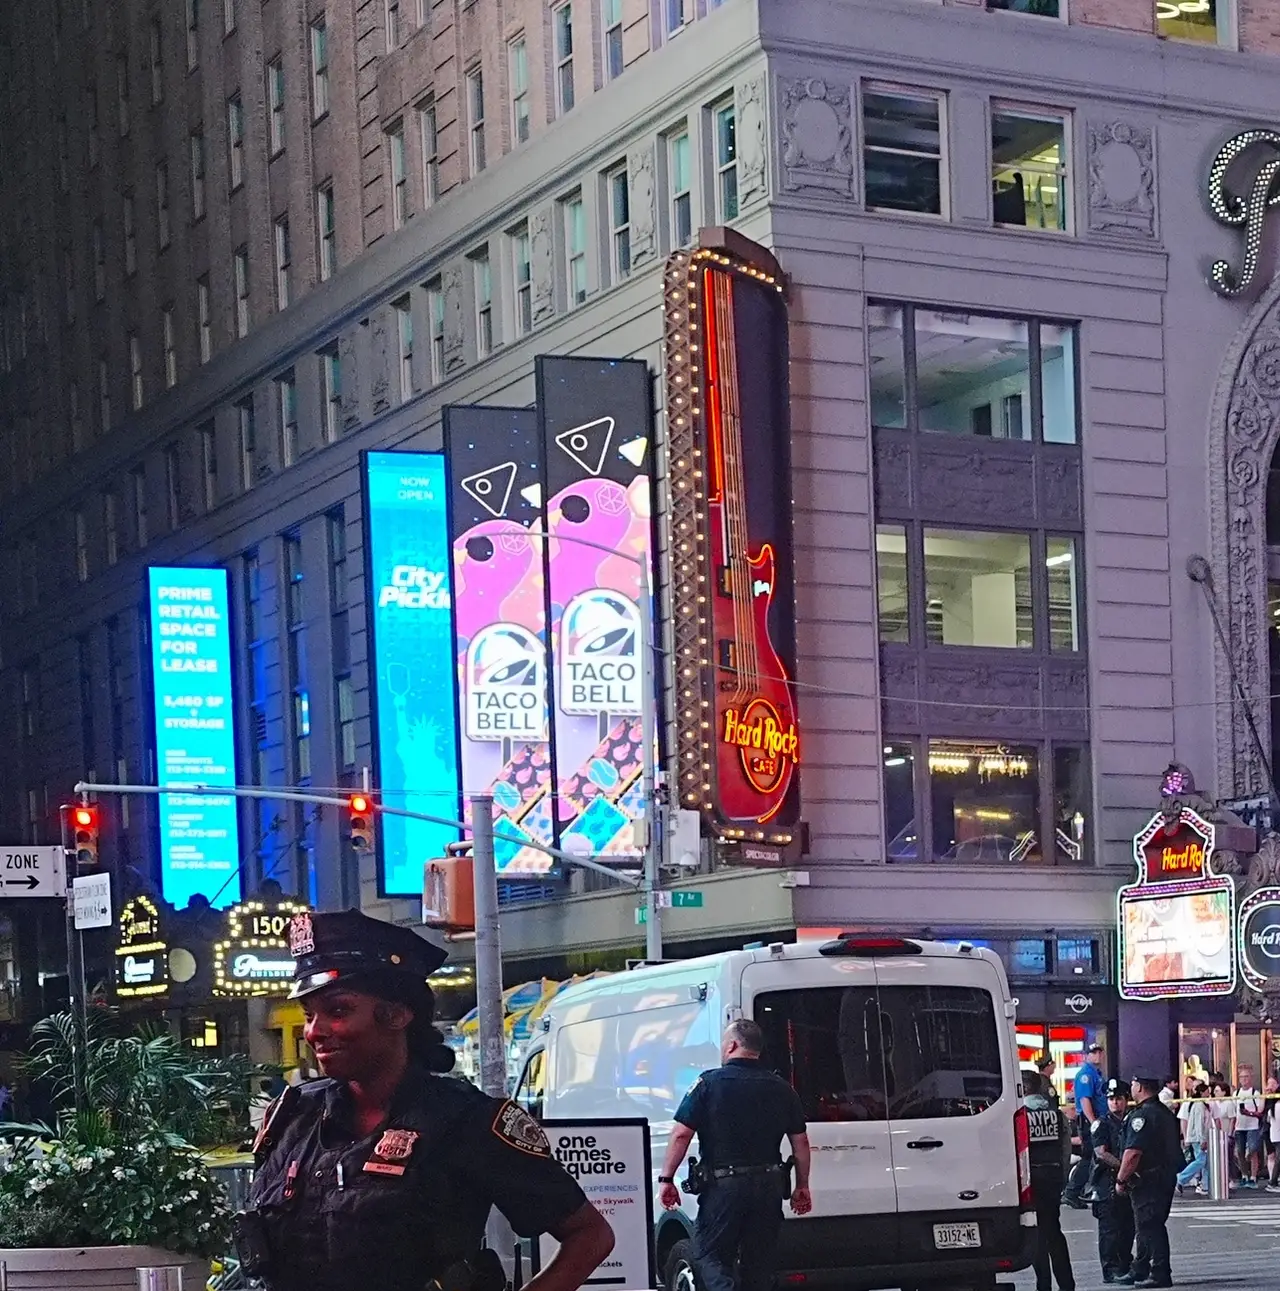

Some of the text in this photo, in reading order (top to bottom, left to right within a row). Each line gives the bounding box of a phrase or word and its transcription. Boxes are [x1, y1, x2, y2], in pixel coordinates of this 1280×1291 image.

[400, 476, 430, 487] NOW
[397, 489, 434, 500] OPEN
[391, 564, 445, 593] City
[158, 586, 212, 600] PRIME
[159, 604, 220, 619] RETAIL
[159, 622, 216, 637] SPACE
[160, 639, 197, 654] FOR
[161, 657, 217, 672] LEASE
[567, 662, 636, 681] TACO
[472, 692, 537, 709] TACO
[572, 685, 634, 703] BELL
[477, 713, 536, 730] BELL
[724, 709, 800, 763] Hard Rock
[753, 757, 776, 775] CAFE
[6, 854, 40, 869] ZONE
[1162, 846, 1188, 871] Hard
[679, 893, 684, 905] 7
[1252, 932, 1273, 947] Hard
[1027, 1110, 1059, 1127] NYPD
[1029, 1122, 1059, 1138] POLICE
[515, 1139, 532, 1150] CITY
[558, 1135, 597, 1149] one
[554, 1147, 611, 1162] times
[583, 1184, 639, 1193] EXPERIENCES
[603, 1197, 634, 1208] Skywalk
[597, 1258, 623, 1268] ickets
